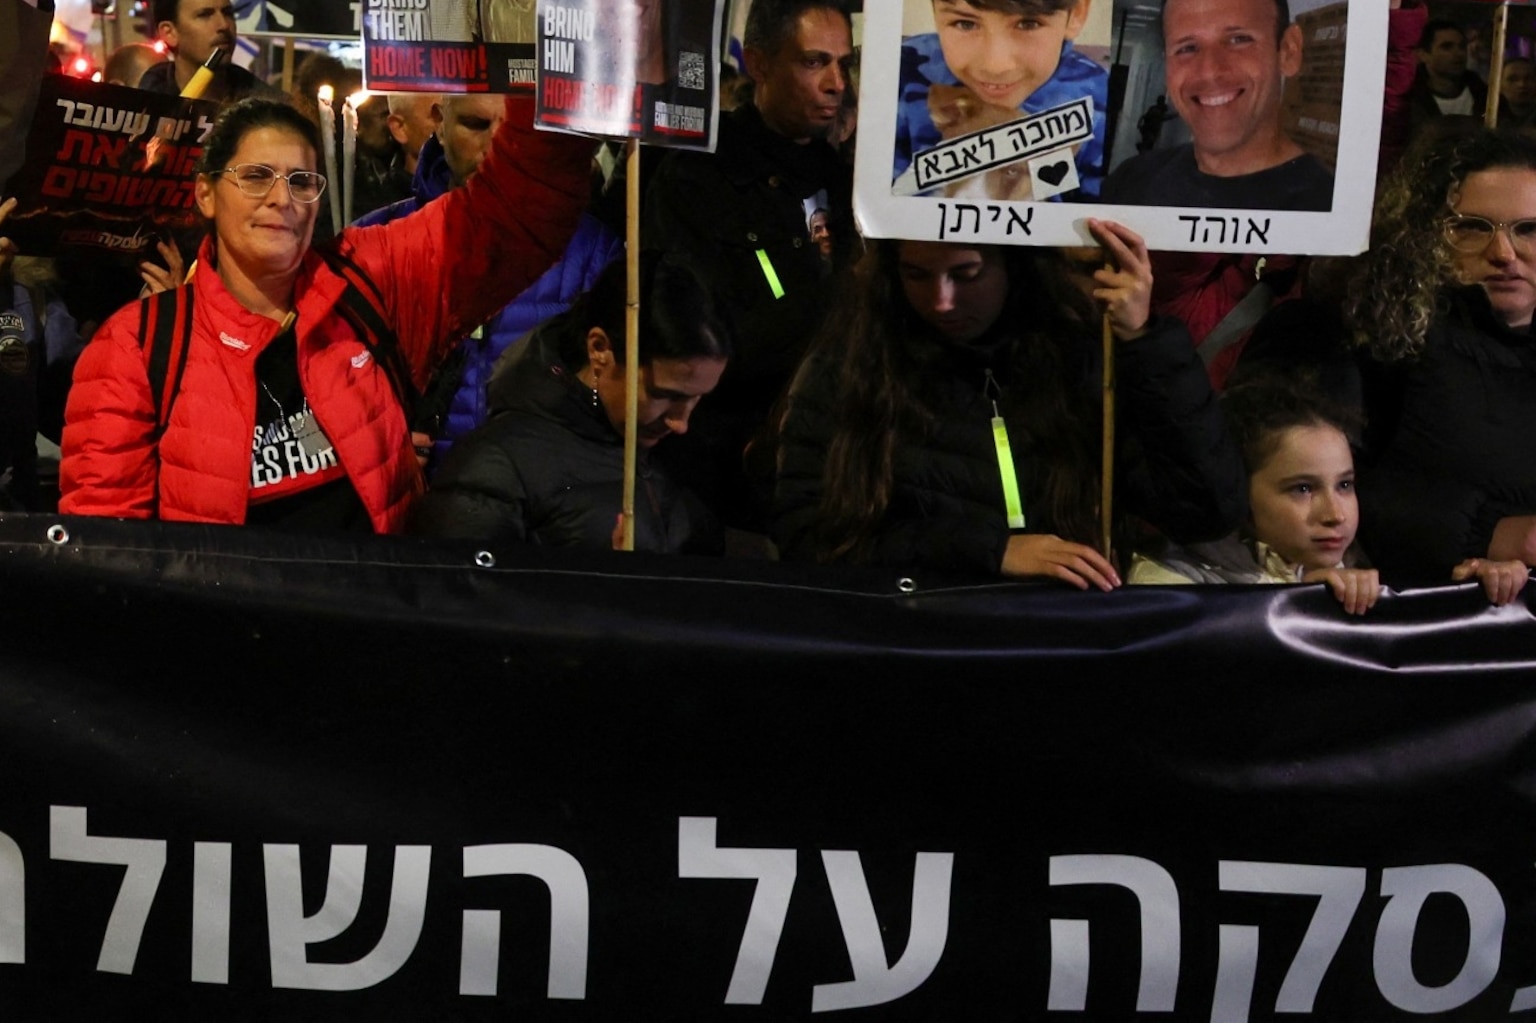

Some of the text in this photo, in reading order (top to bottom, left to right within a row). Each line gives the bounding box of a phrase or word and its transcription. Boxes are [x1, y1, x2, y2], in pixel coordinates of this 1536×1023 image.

[368, 9, 423, 42] THEM
[369, 44, 488, 80] HOME NOW!
[543, 39, 575, 74] HIM
[56, 98, 151, 138] שעובר
[155, 116, 192, 141] יום
[56, 129, 126, 169] את
[923, 110, 1086, 180] מחכה לאבא
[41, 165, 197, 208] החטופים
[938, 202, 1035, 240] איתן
[1178, 214, 1271, 245] אוהד
[678, 816, 955, 1013] על
[1048, 854, 1536, 1023] סקה
